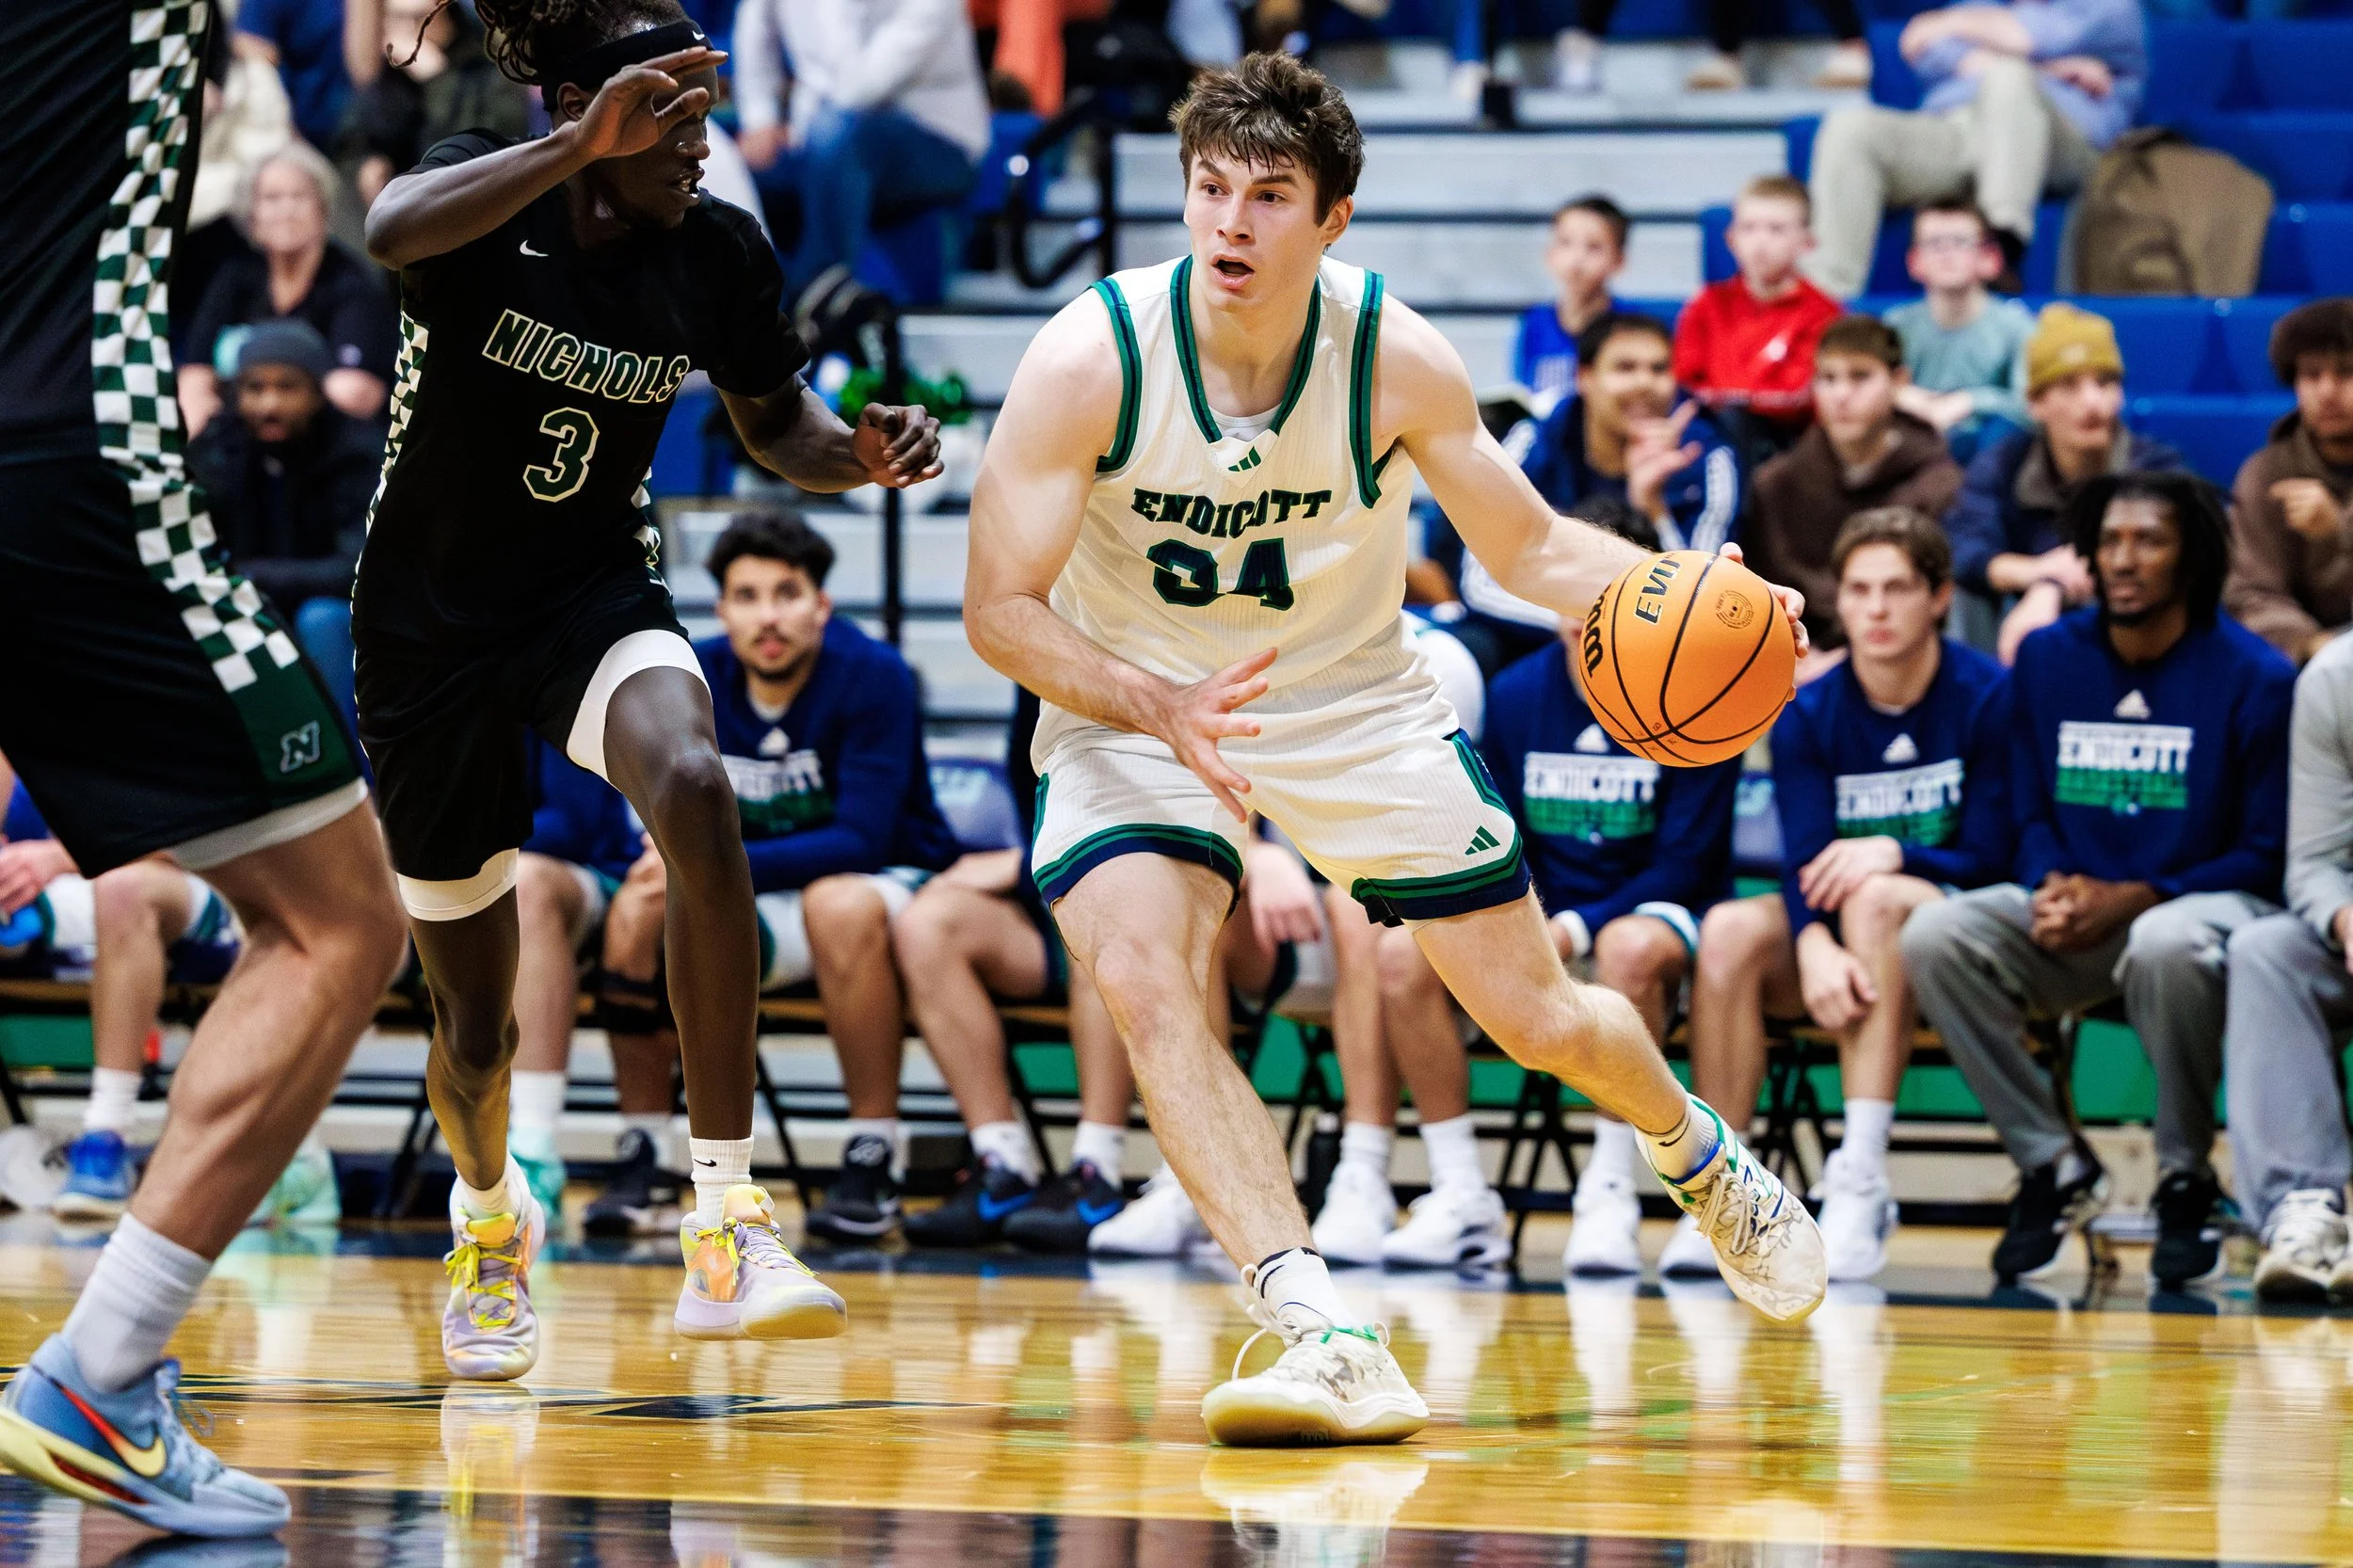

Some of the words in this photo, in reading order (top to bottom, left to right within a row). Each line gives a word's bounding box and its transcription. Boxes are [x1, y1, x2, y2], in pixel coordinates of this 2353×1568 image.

[482, 309, 690, 403] NICHOLS
[522, 407, 600, 503] 3
[1131, 488, 1333, 539] ENDICOTT
[280, 720, 321, 773] N
